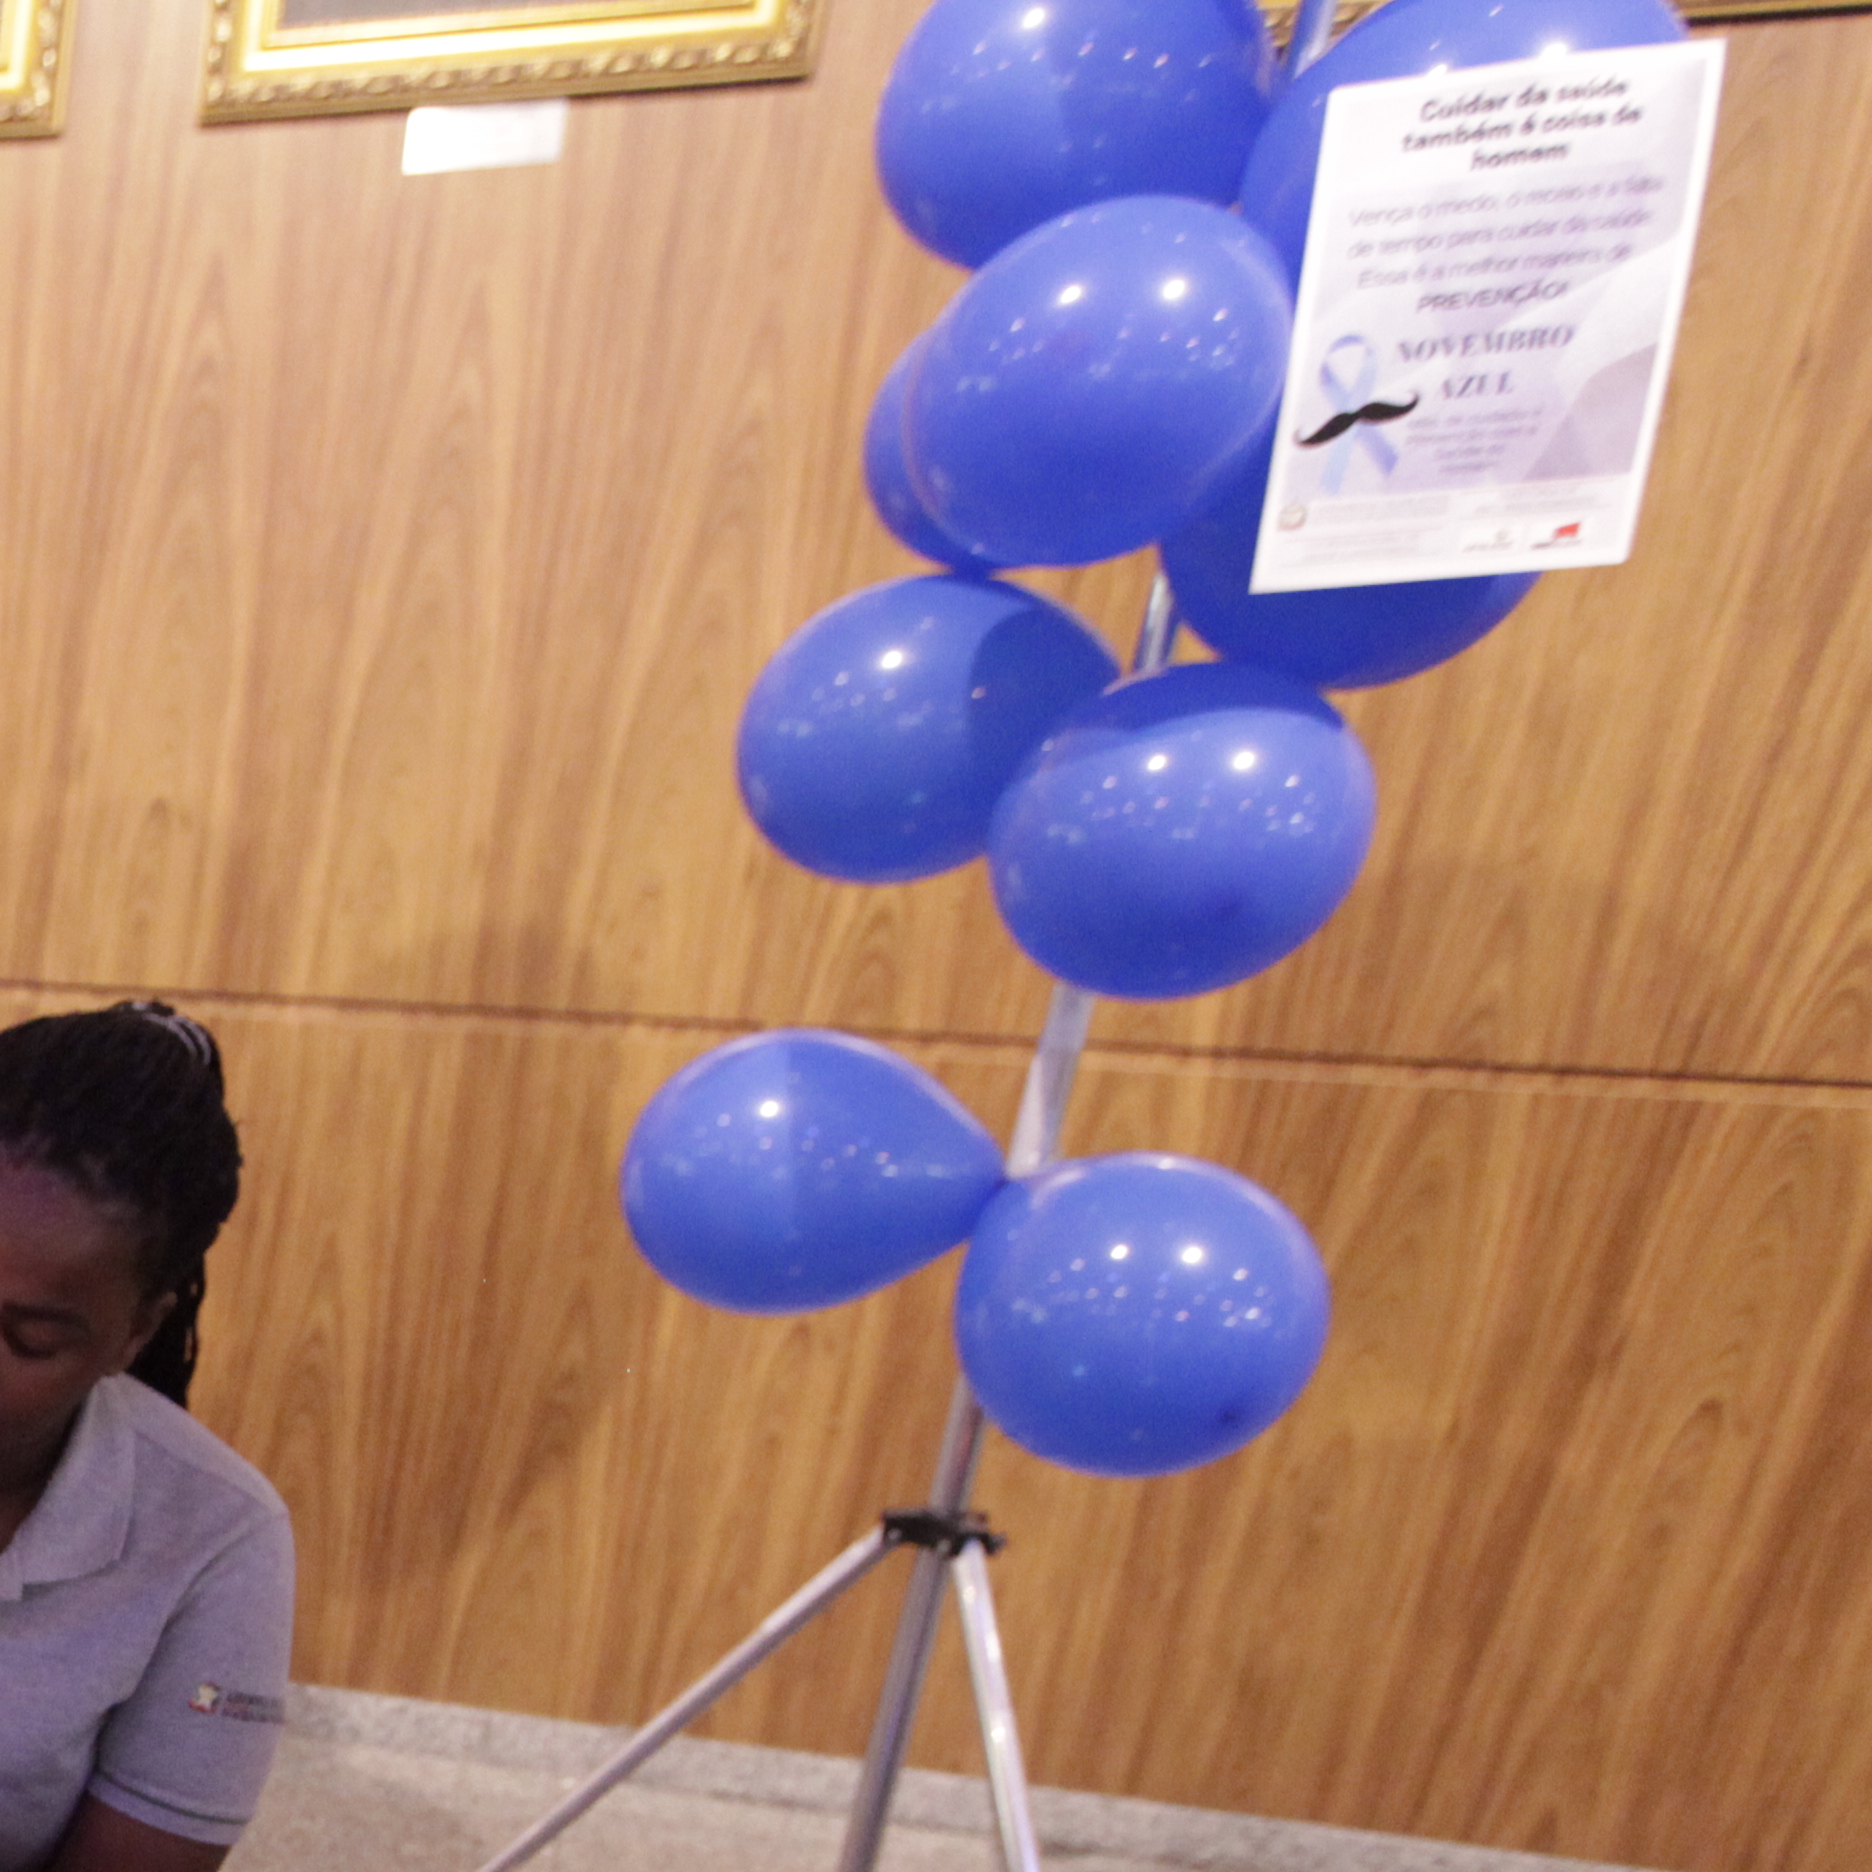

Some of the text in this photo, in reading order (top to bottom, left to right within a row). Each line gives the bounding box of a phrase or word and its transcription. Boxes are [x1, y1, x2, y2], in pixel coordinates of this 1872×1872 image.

[1419, 90, 1510, 123] Cuidar
[1516, 82, 1550, 109] da
[1402, 117, 1512, 152] também
[1542, 108, 1606, 133] coisa
[1612, 101, 1644, 126] de
[1469, 141, 1571, 171] homem
